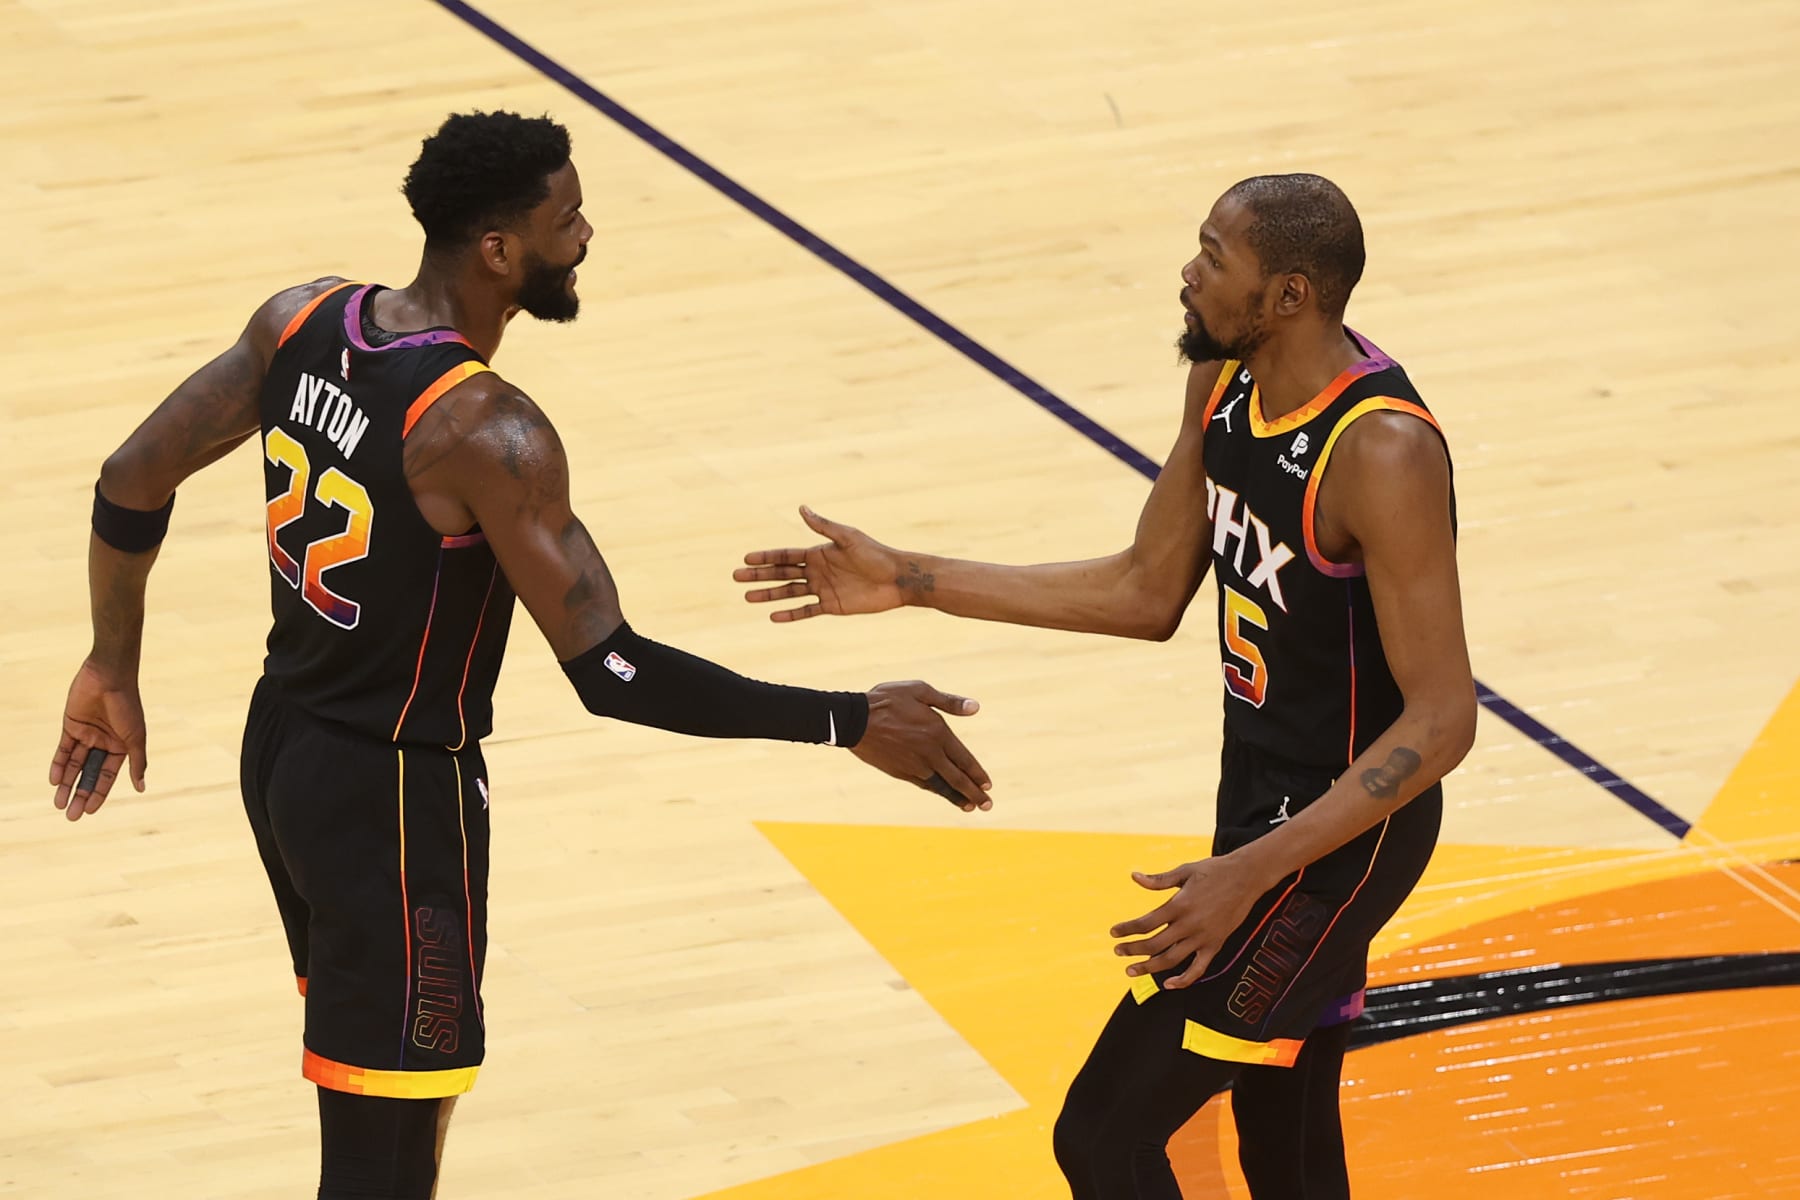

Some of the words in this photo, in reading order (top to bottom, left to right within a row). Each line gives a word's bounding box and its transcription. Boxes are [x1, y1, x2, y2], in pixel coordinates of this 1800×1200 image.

[288, 372, 370, 460] AYTON
[1277, 453, 1308, 480] PayPal
[265, 426, 374, 630] 22
[1222, 583, 1269, 709] 5
[412, 906, 463, 1053] SUNS
[1227, 891, 1327, 1024] SUNS
